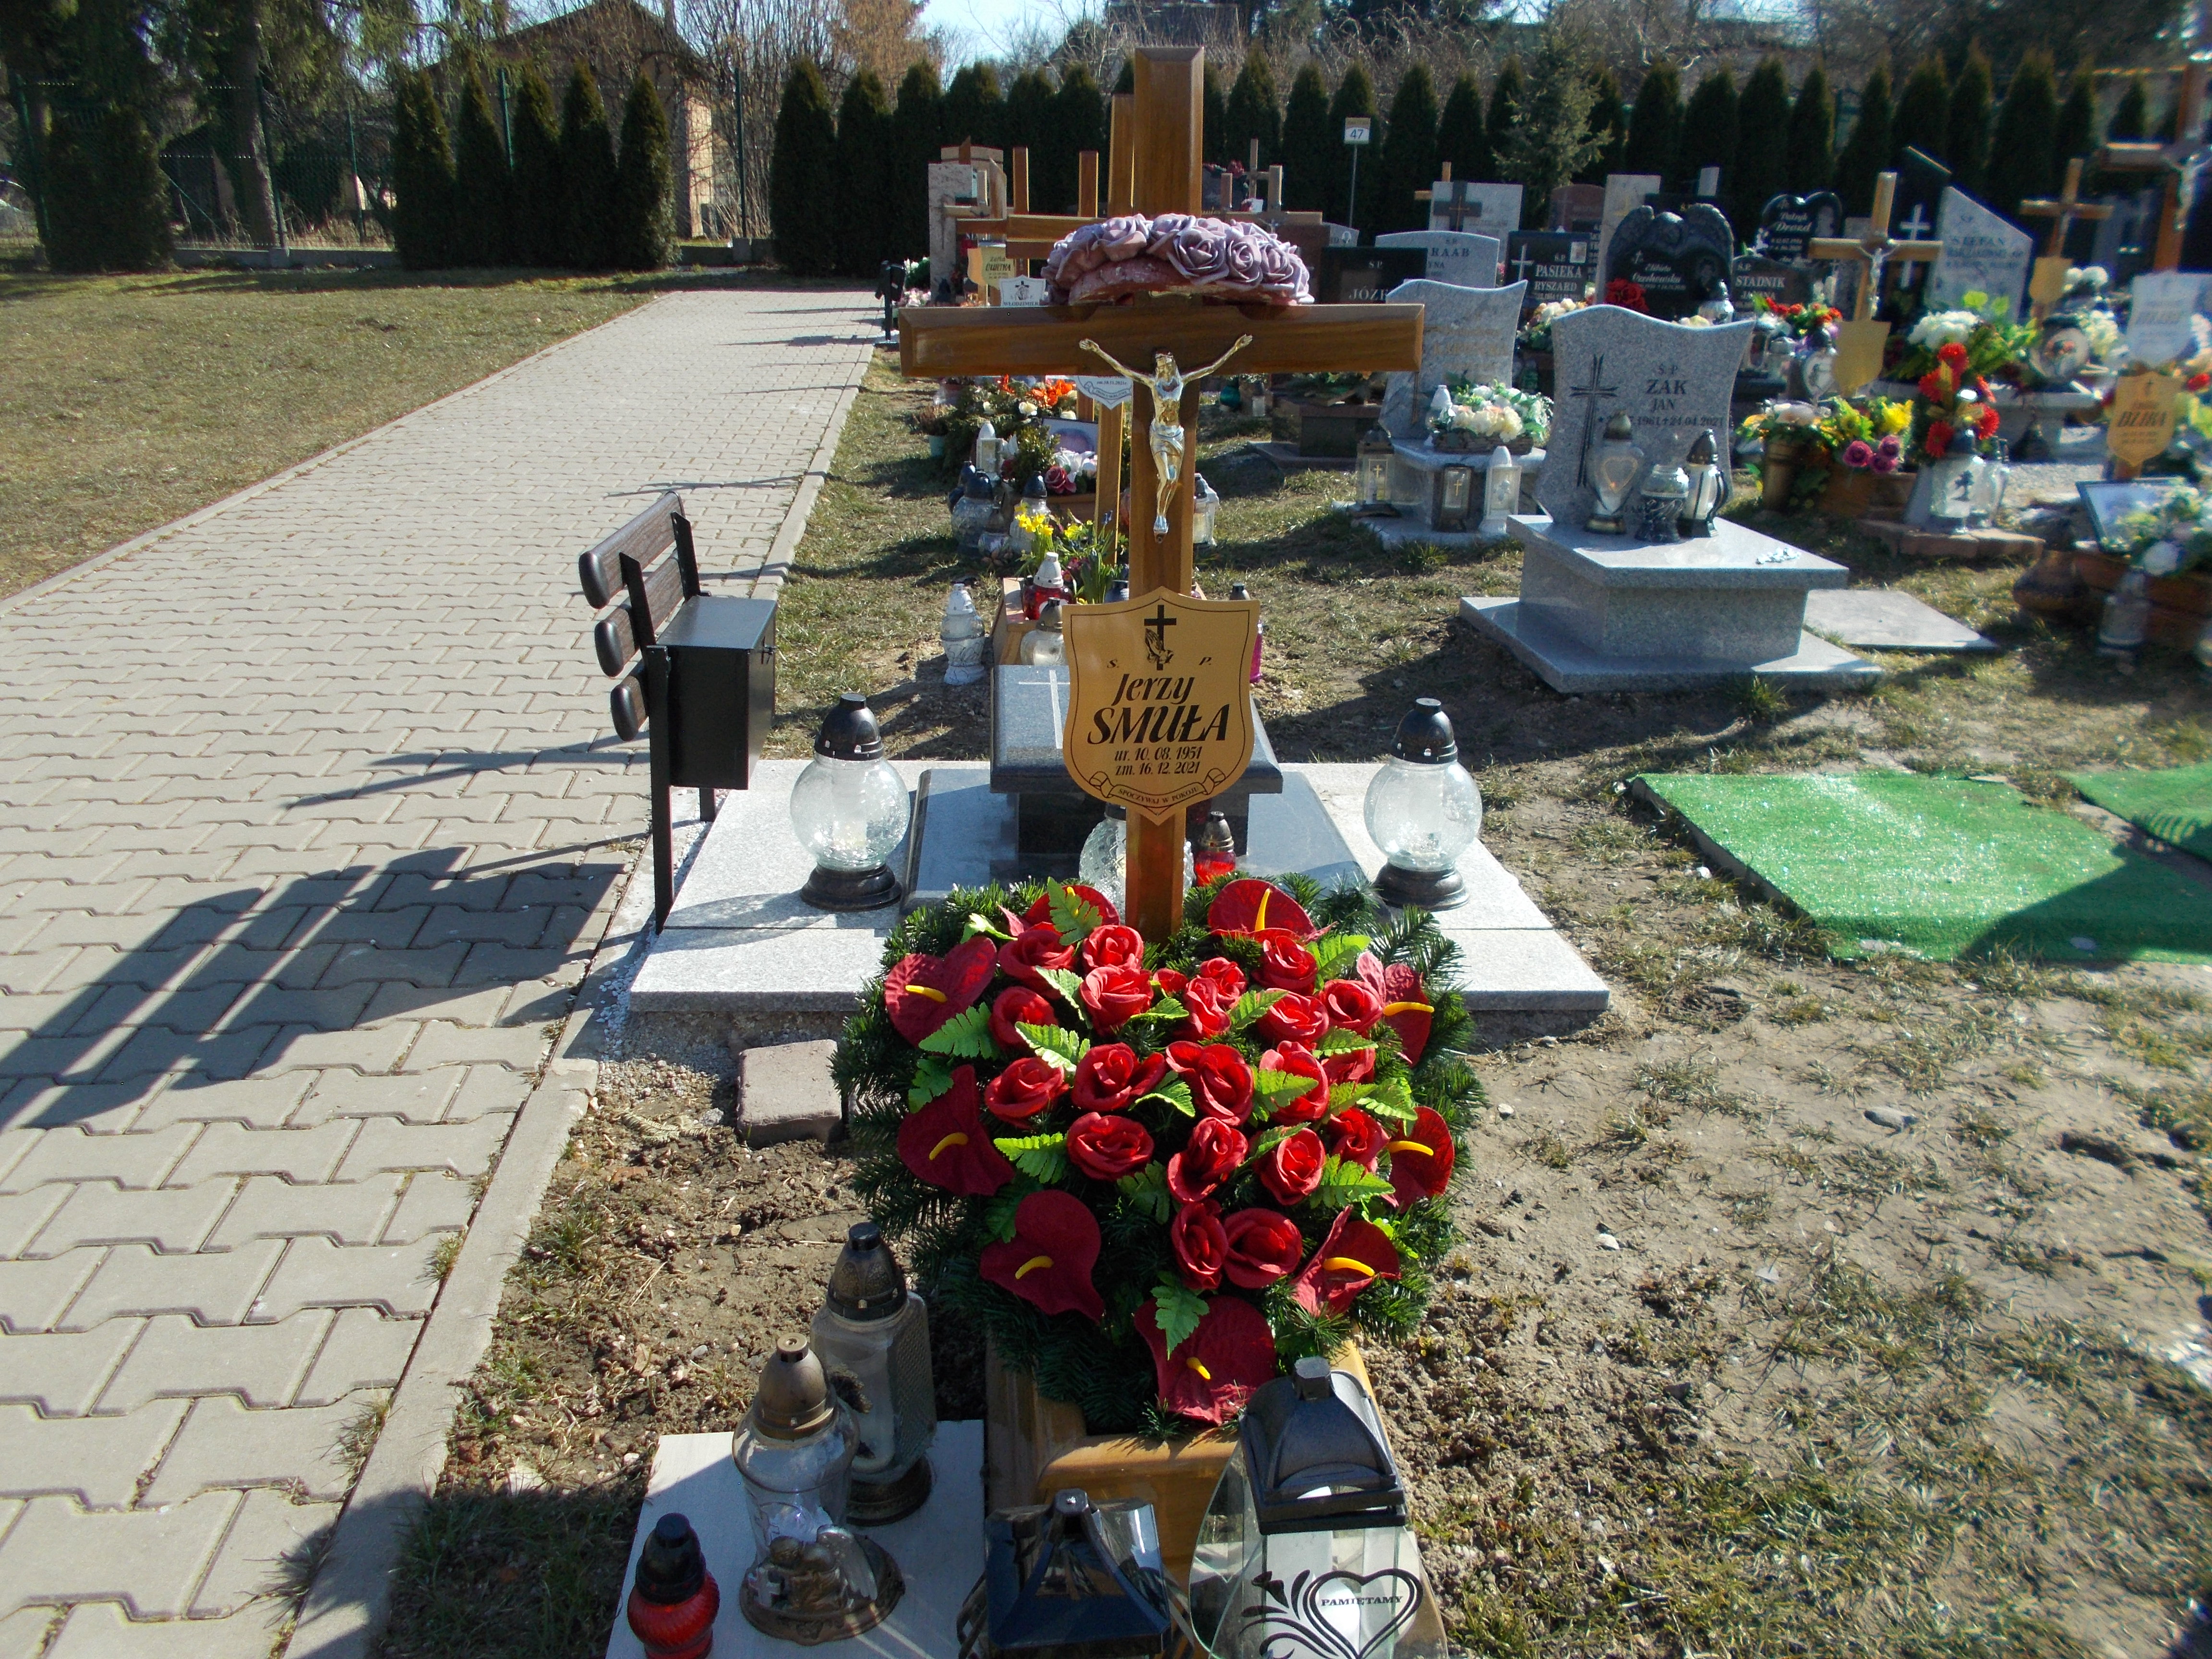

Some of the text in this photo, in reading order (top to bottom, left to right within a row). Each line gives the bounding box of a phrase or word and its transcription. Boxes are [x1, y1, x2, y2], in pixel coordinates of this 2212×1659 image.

[1350, 128, 1364, 139] 47
[1431, 247, 1469, 257] RAAB
[1535, 264, 1582, 278] PASIEKA
[1534, 280, 1577, 291] RYSZARD
[1735, 276, 1785, 288] STADNIK
[1650, 398, 1676, 412] JAN
[1111, 673, 1195, 706] Jerzy
[1087, 704, 1230, 745] SMUŁA
[1114, 746, 1202, 761] ur. 10. 08. 1951
[1115, 761, 1200, 776] zm. 16. 12. 2021
[1118, 789, 1159, 804] SPOCZYWAJ
[1172, 786, 1199, 801] POKOJU
